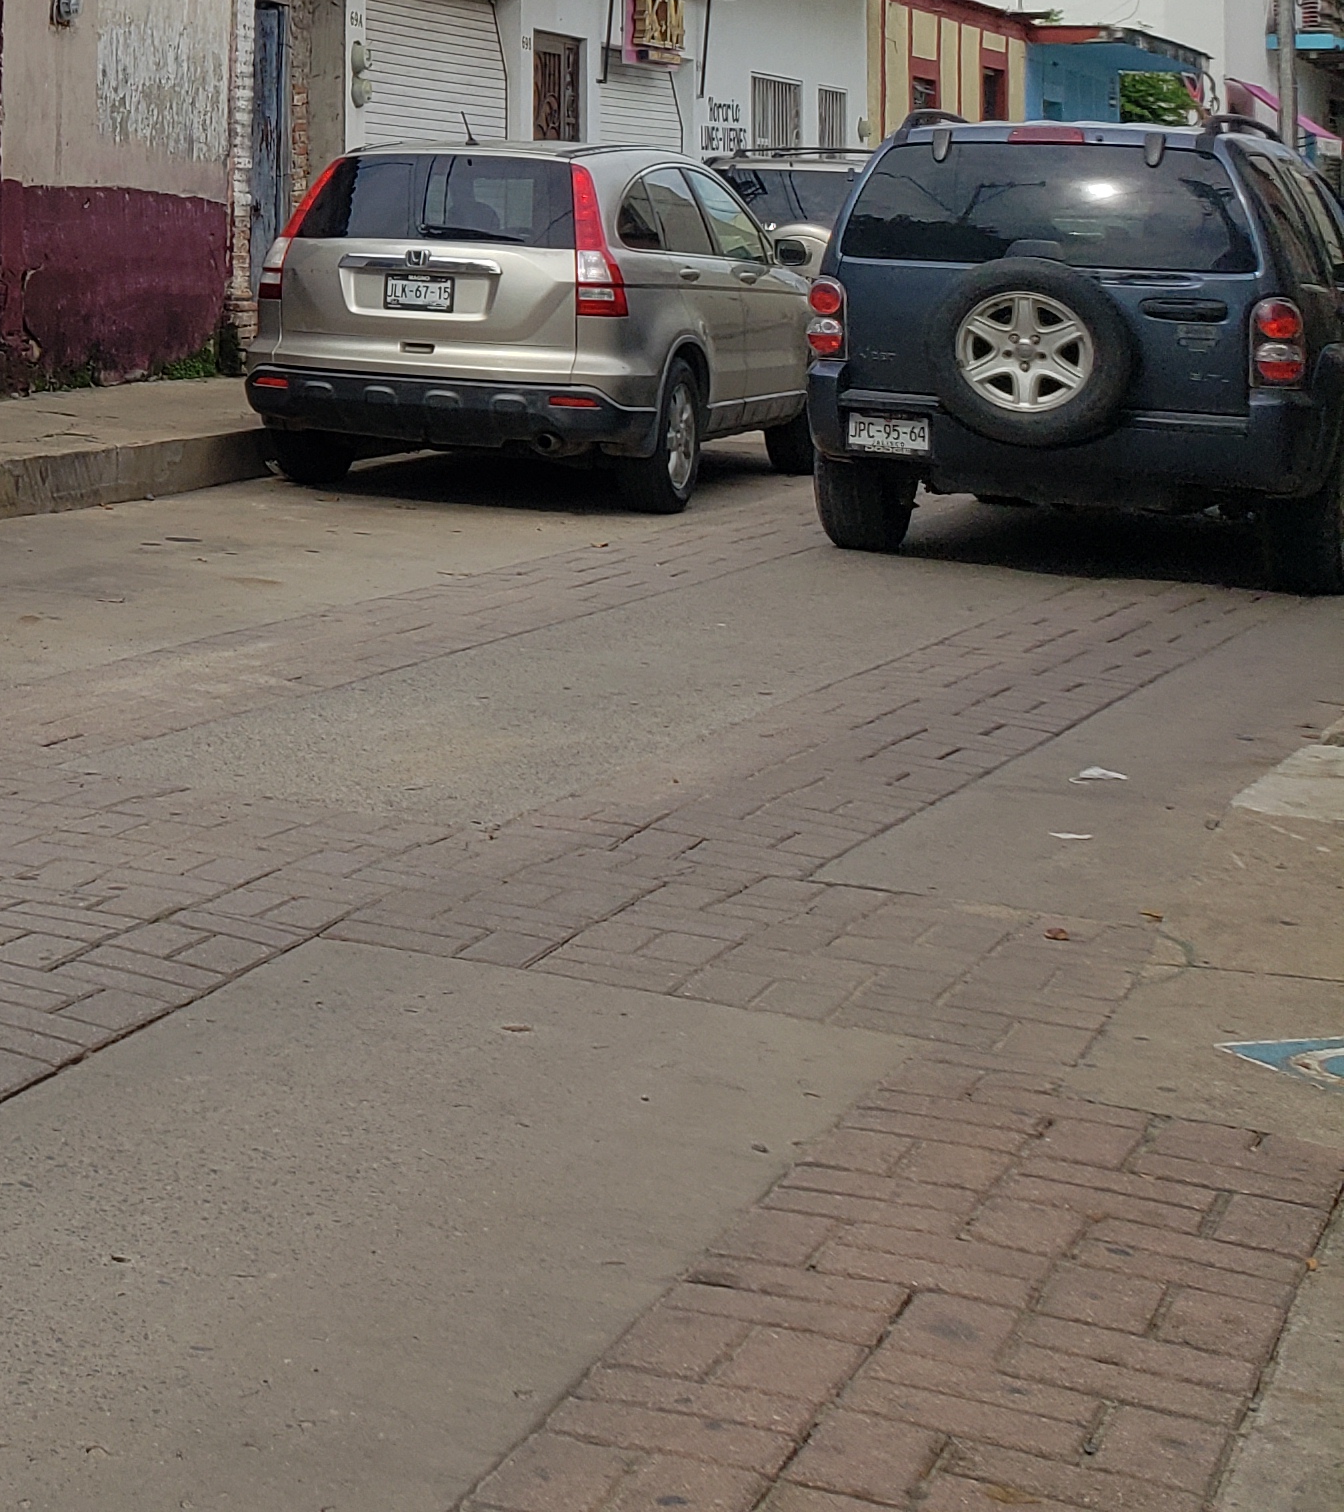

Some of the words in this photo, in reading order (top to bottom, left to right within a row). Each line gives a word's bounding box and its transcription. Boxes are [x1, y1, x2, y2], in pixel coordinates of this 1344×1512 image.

[707, 96, 741, 123] Horario
[387, 283, 450, 300] JLK-67-15
[849, 421, 926, 443] JPC-95-64
